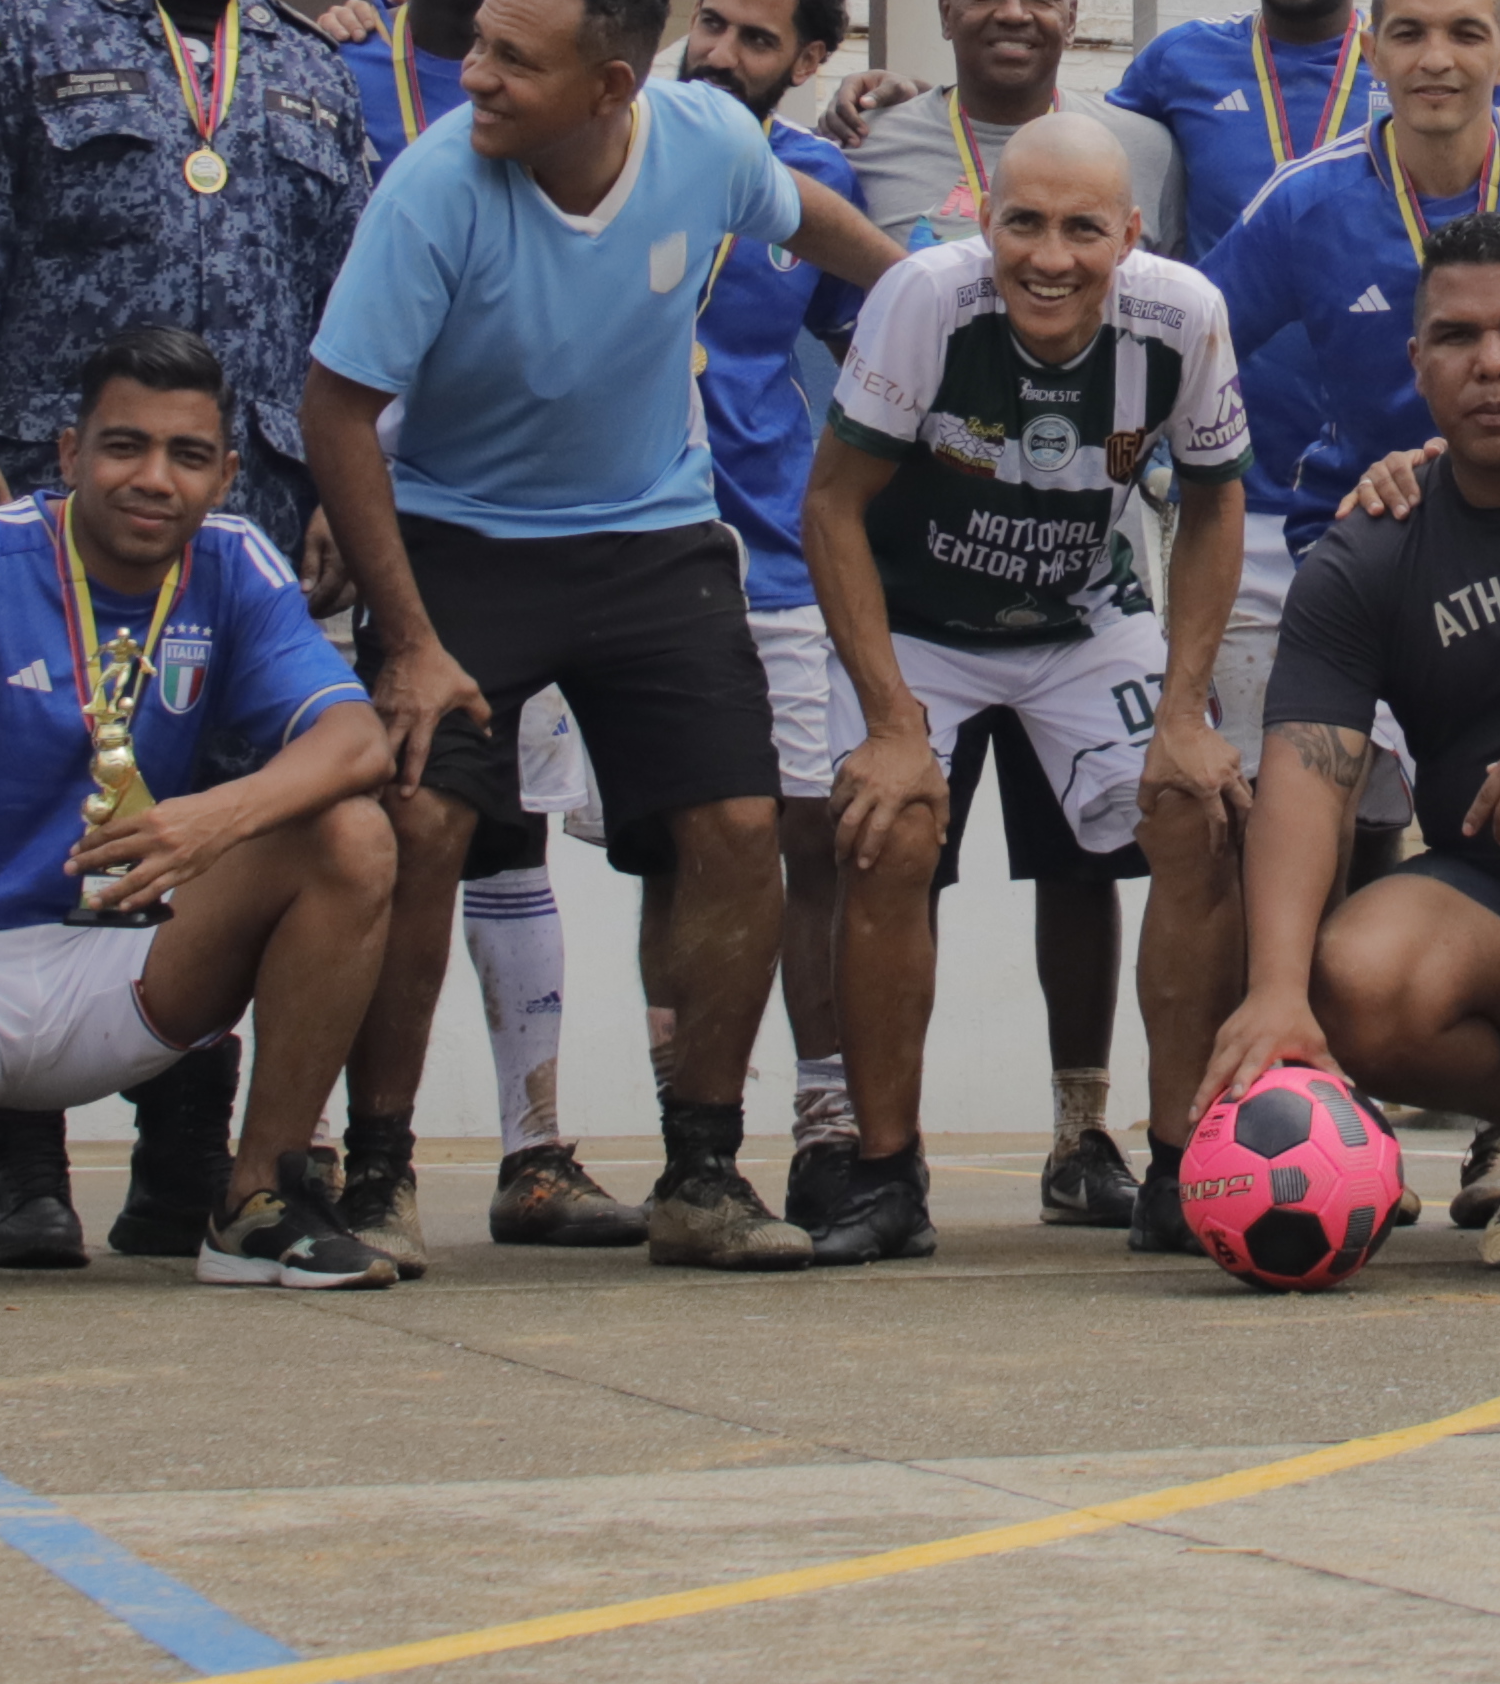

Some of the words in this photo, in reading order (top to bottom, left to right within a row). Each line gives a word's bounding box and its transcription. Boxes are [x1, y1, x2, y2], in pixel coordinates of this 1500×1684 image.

[927, 519, 1029, 584] SENIOR
[966, 508, 1101, 553] NATIONAL
[167, 644, 206, 660] ITALIA
